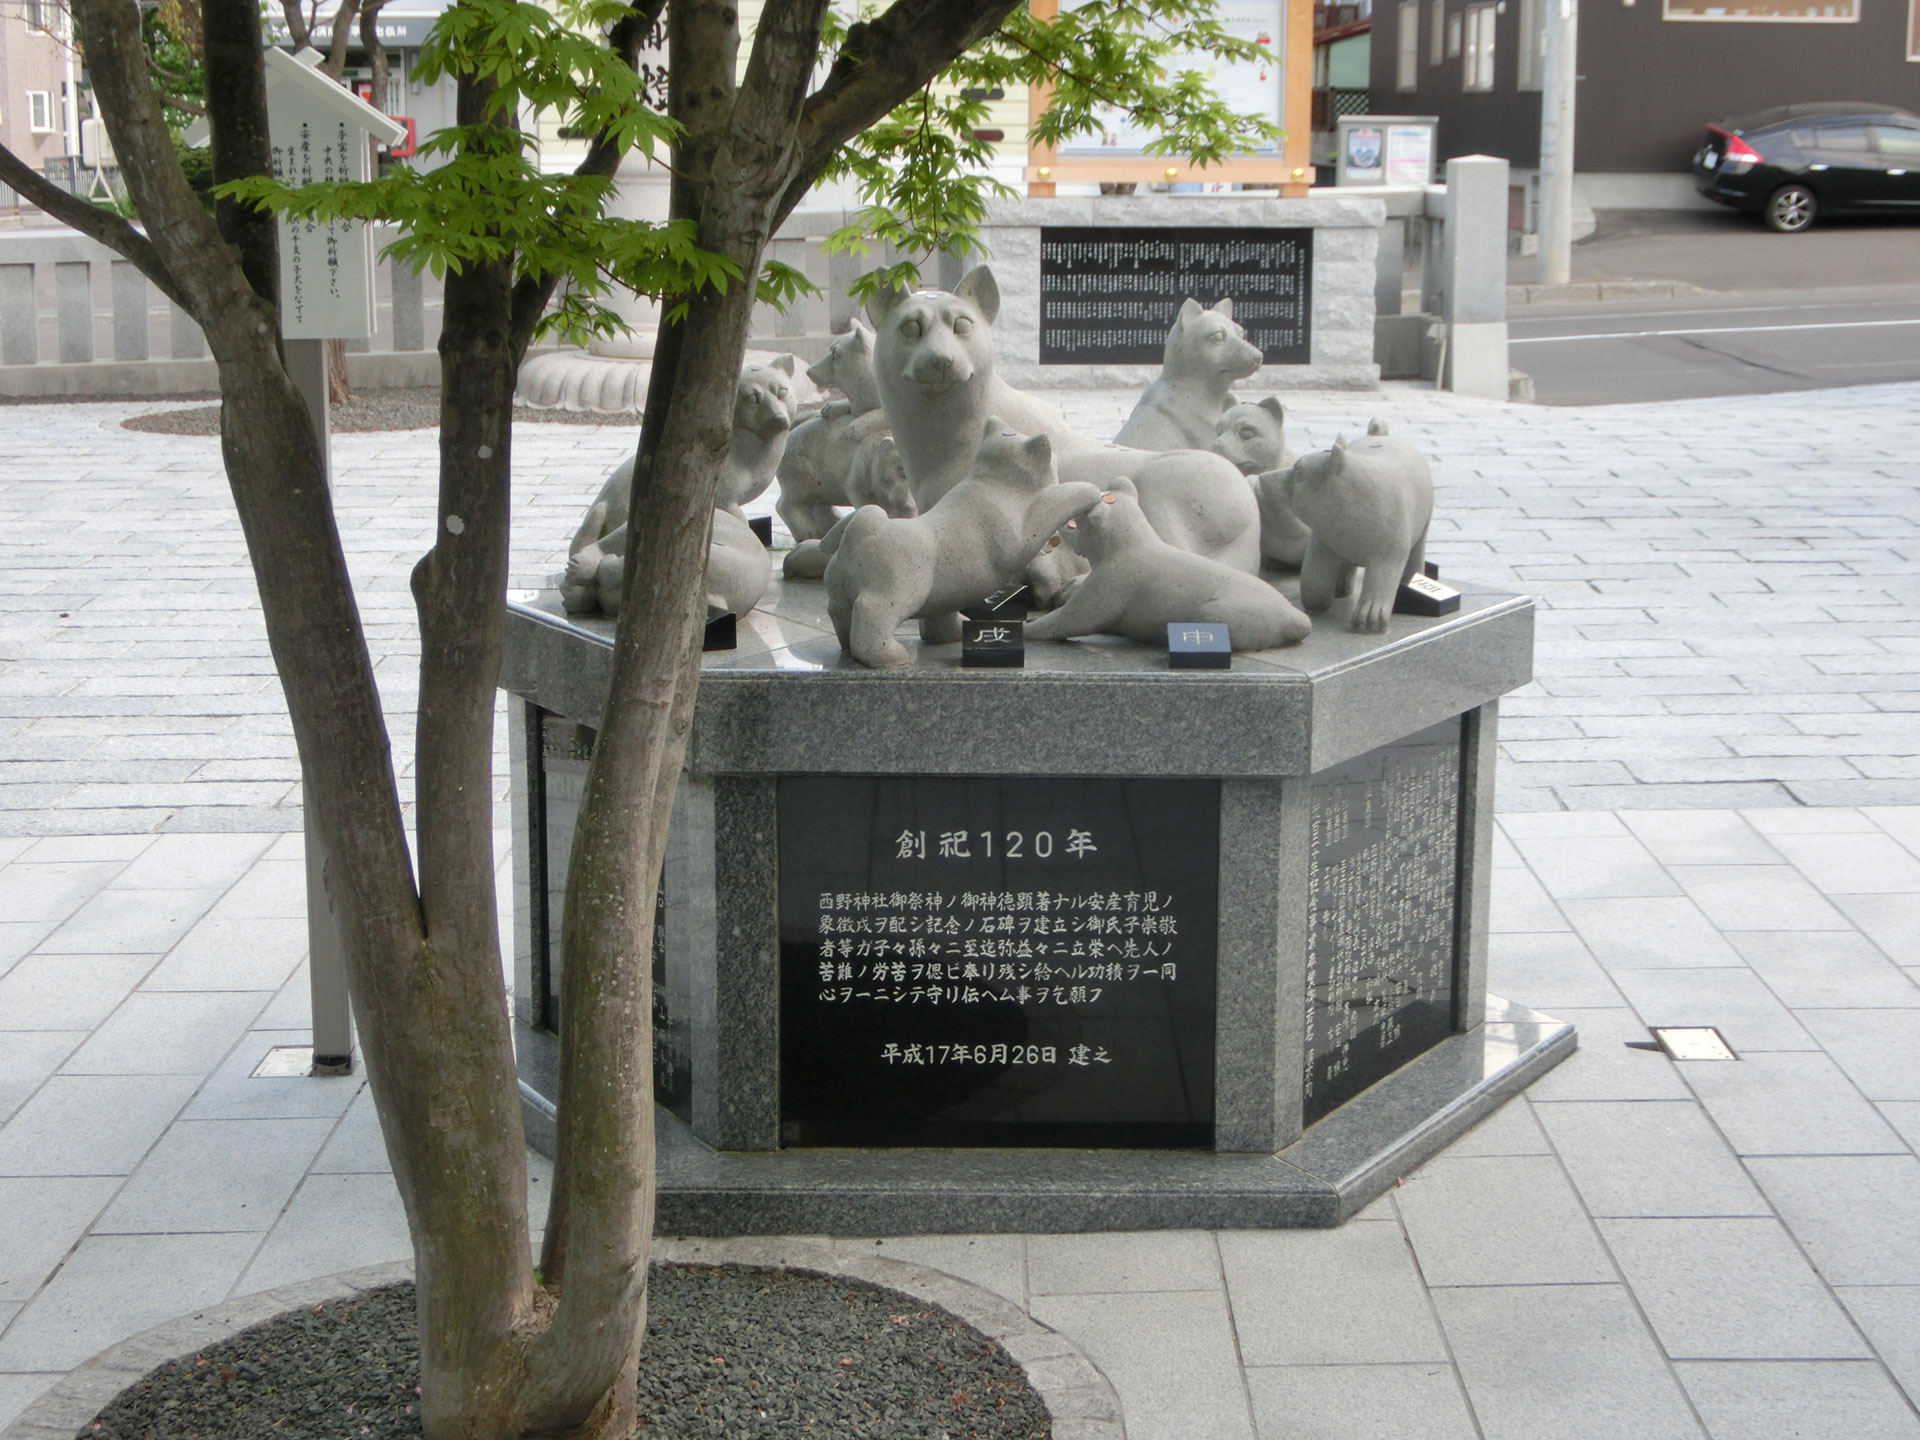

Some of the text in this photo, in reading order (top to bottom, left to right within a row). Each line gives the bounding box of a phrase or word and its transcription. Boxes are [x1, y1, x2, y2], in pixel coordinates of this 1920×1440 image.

[881, 1044, 1112, 1065] 平成17年6月26日 建之
